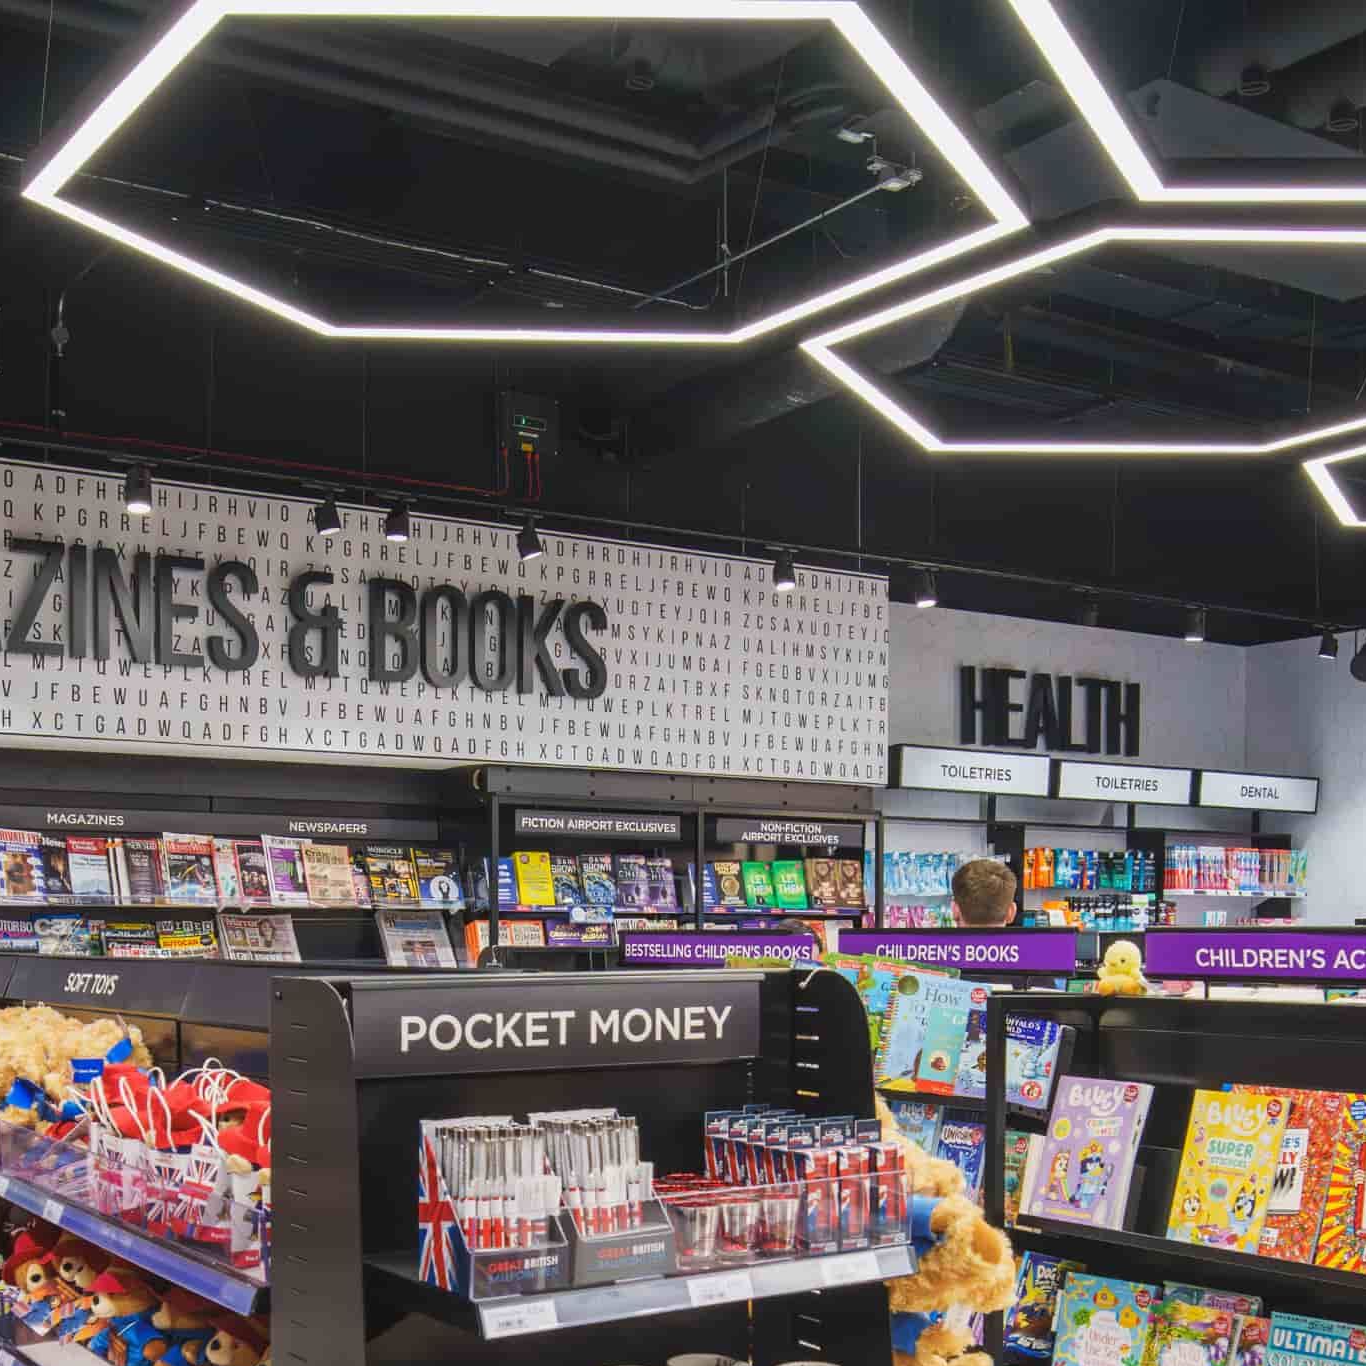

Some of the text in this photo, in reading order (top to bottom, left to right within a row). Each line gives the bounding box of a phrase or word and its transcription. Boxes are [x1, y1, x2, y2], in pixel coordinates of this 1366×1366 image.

[288, 570, 343, 679] &
[368, 577, 609, 700] BOOKS
[959, 665, 1141, 757] HEALTH
[940, 764, 1012, 783] TOILETRIES
[1095, 776, 1159, 791] TOILETRIES
[1240, 785, 1280, 799] DENTAL
[47, 813, 124, 826] MAGAZINES
[289, 821, 367, 834] NEWSPAPERS
[522, 817, 676, 834] FICTION AIRPORT EXCLUSIVES
[761, 823, 821, 834] NON-FICTION
[741, 832, 839, 845] AIRPORT EXCLUSIVES
[625, 943, 810, 960] BESTSELLING CHILDREN'S BOOKS
[876, 944, 1020, 962] CHILDREN'S BOOKS
[1195, 947, 1326, 969] CHILDREN'S
[64, 973, 119, 995] SOFT TOYS
[400, 1006, 733, 1052] POCKET MONEY
[1207, 1139, 1254, 1158] SUPER
[632, 1240, 666, 1257] BRITISH
[523, 1254, 560, 1270] BRITISH
